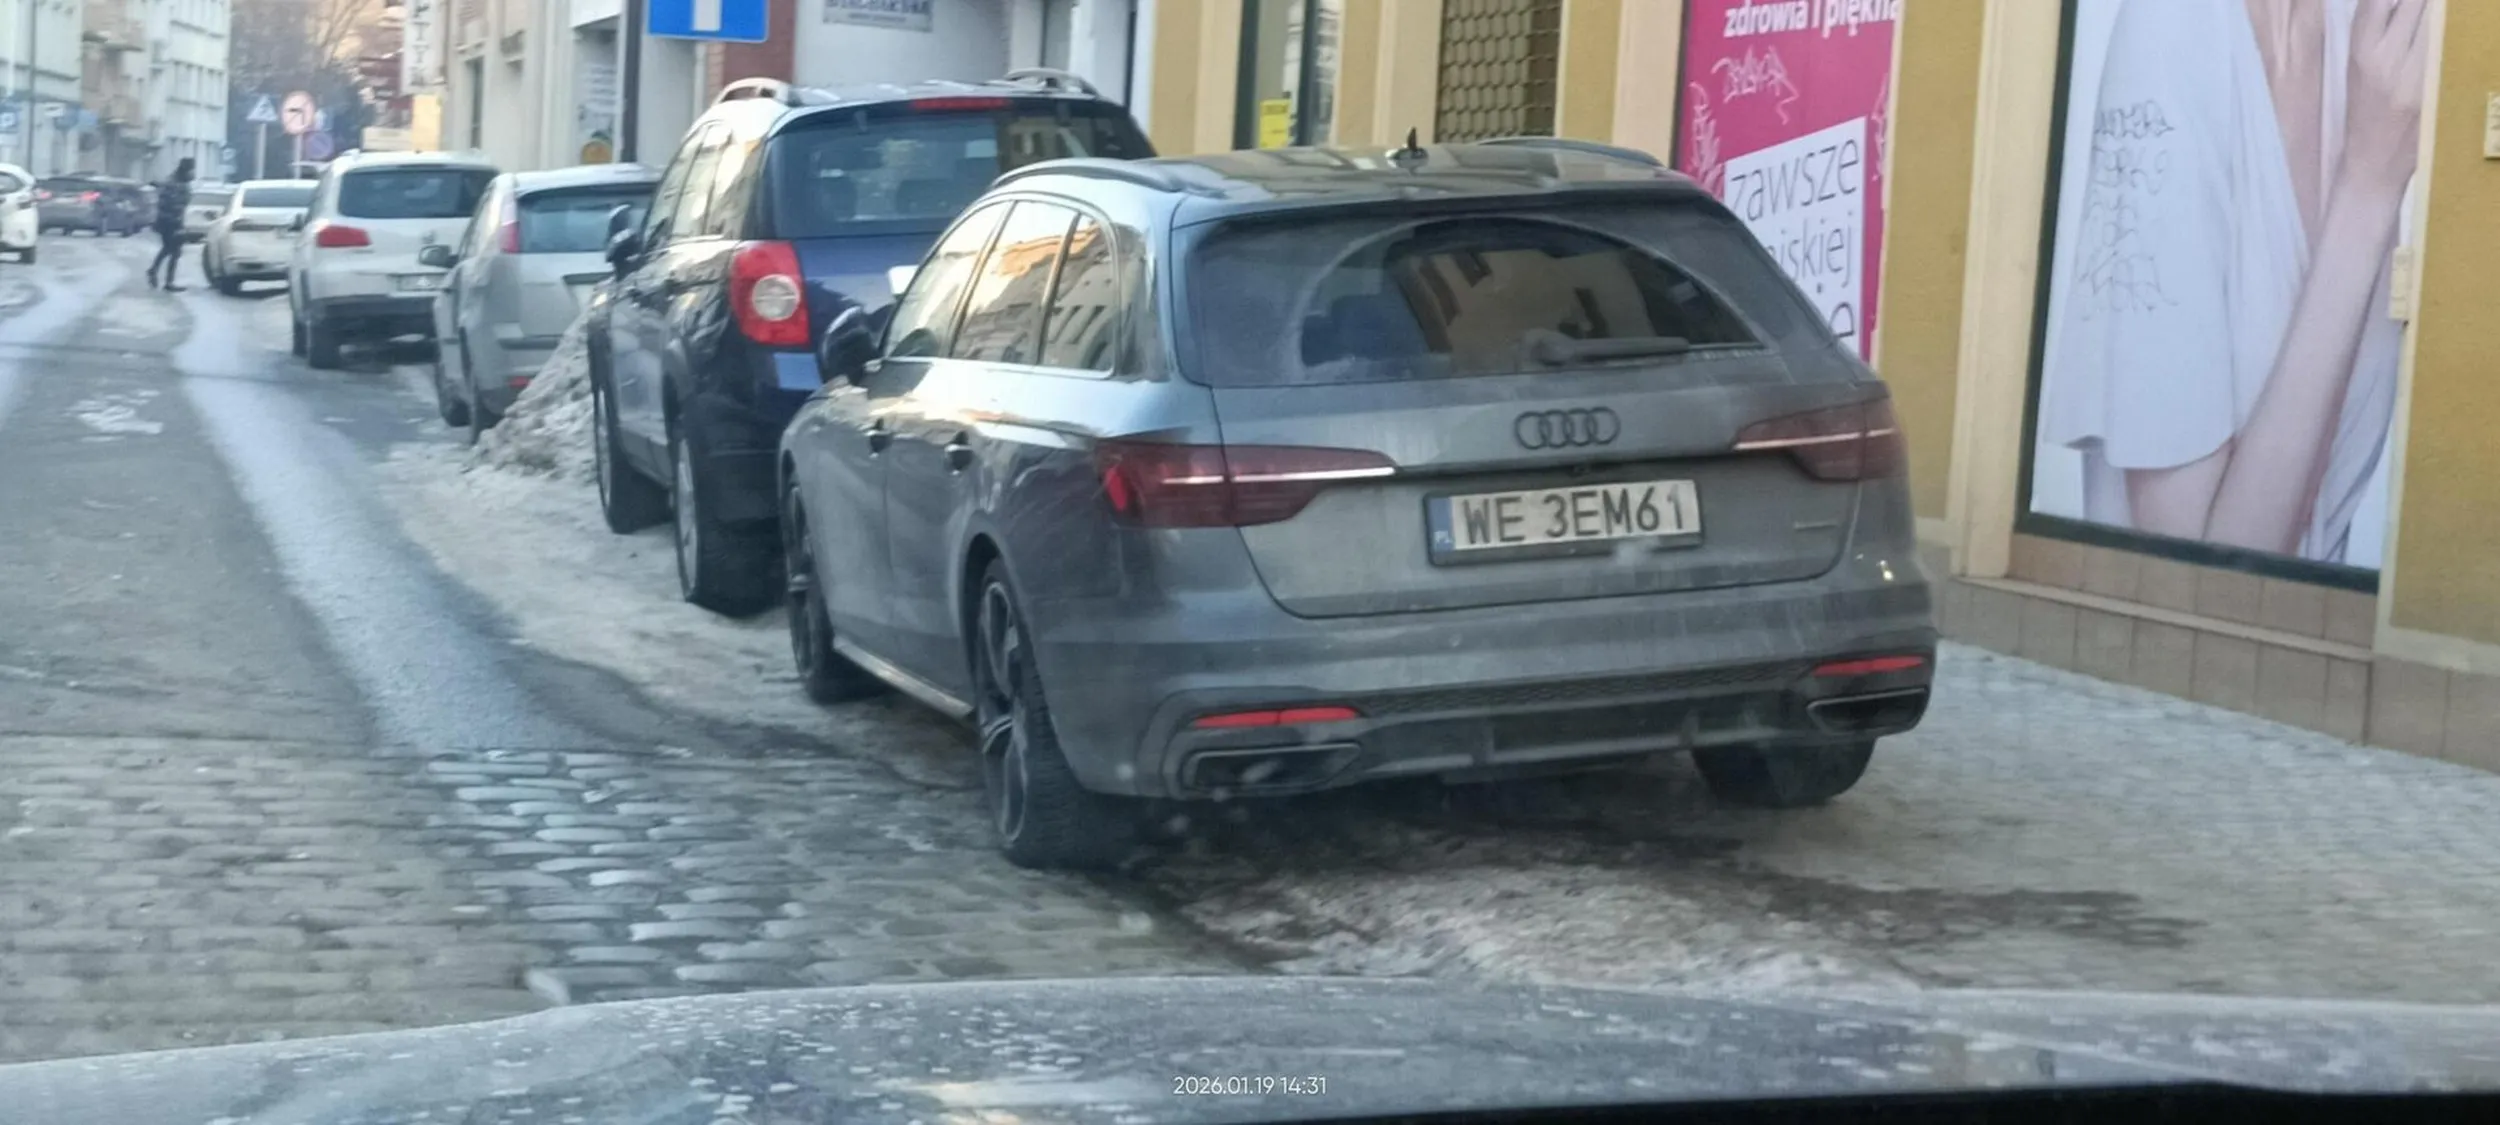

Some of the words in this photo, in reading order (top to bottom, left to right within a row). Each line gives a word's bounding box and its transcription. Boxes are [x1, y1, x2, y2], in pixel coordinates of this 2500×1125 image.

[1723, 0, 1807, 37] zdrowia
[1731, 139, 1859, 222] zawsze
[1767, 210, 1852, 288] iskiej
[1463, 497, 1525, 545] WE
[1543, 484, 1684, 538] 3EM61
